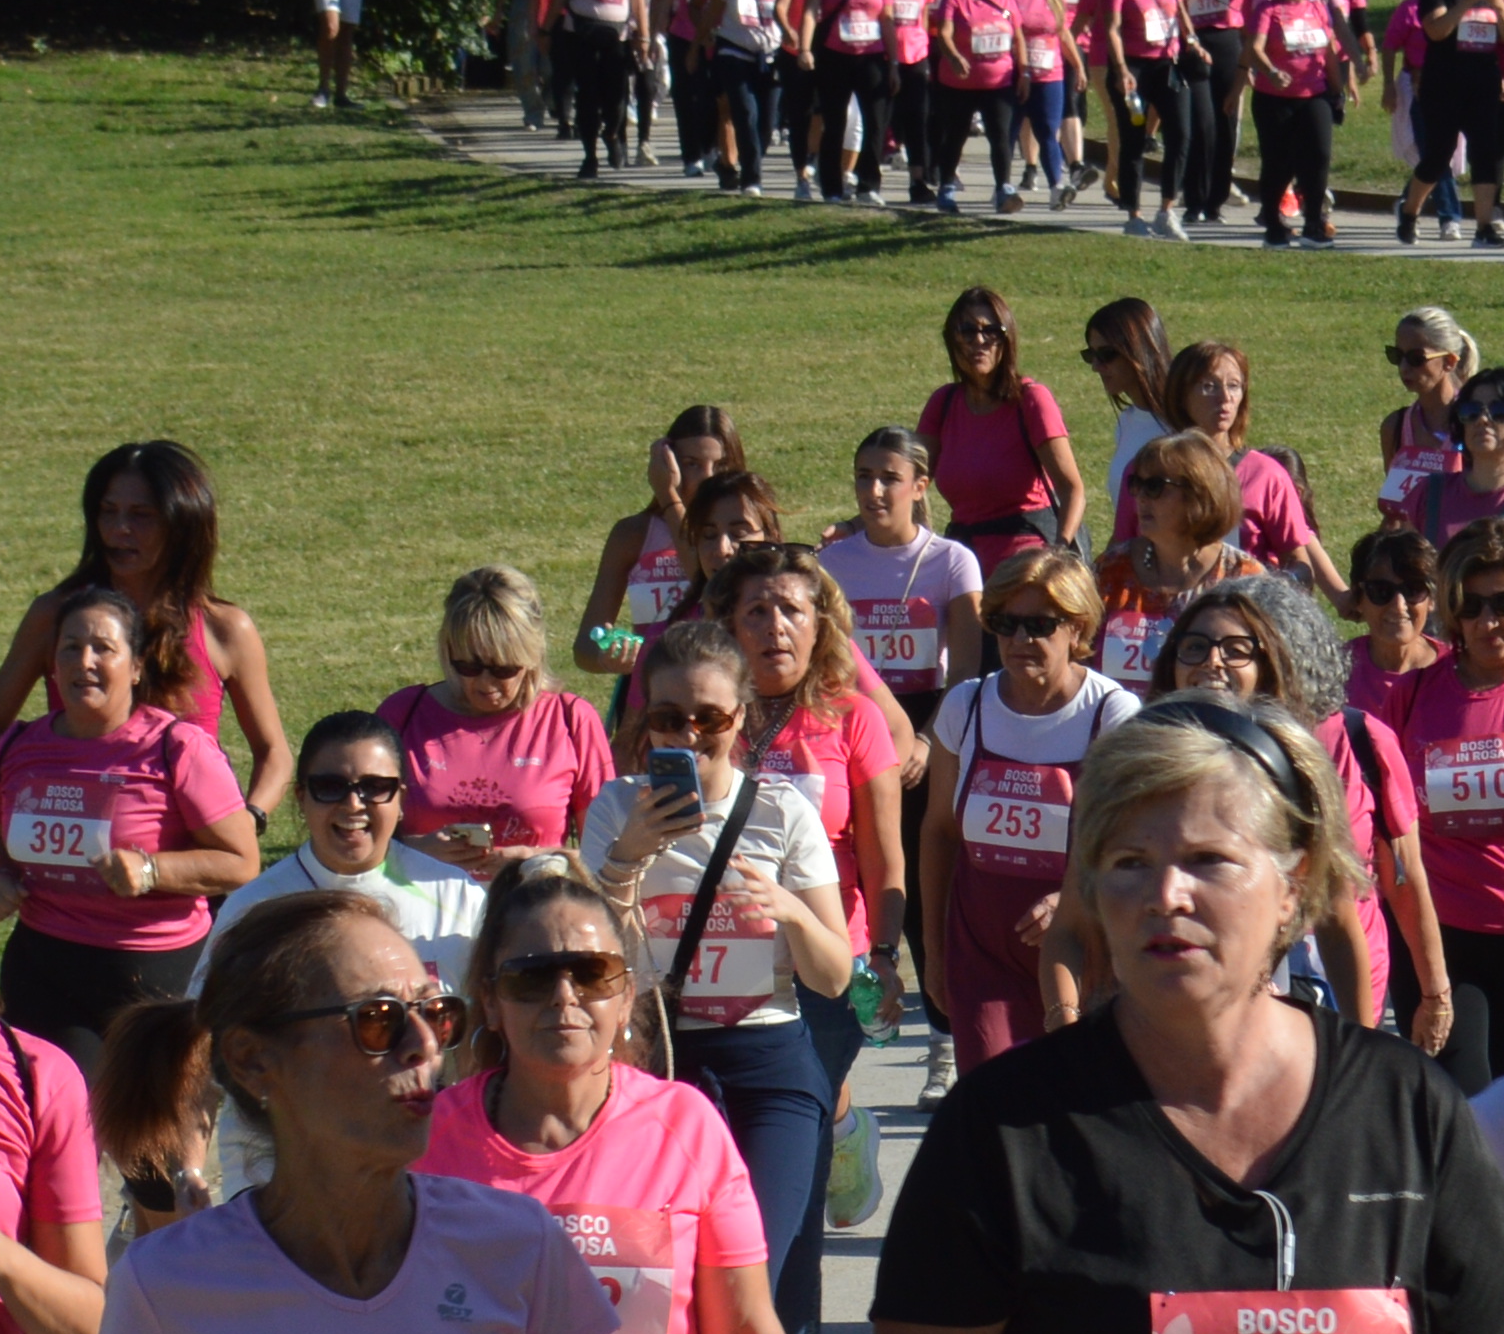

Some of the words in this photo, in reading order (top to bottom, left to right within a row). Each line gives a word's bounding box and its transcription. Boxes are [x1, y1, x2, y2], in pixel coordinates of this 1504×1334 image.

[872, 604, 909, 616] BOSCO
[868, 615, 881, 626] IN
[864, 633, 915, 661] 130
[1459, 737, 1503, 752] BOSCO
[1456, 752, 1467, 763] IN
[1004, 769, 1042, 785] BOSCO
[46, 785, 84, 799] BOSCO
[998, 780, 1012, 793] IN
[1013, 783, 1042, 797] ROSA
[39, 797, 53, 811] IN
[54, 798, 84, 813] ROSA
[985, 802, 1042, 840] 253
[29, 820, 85, 857] 392
[554, 1214, 610, 1236] OSCO
